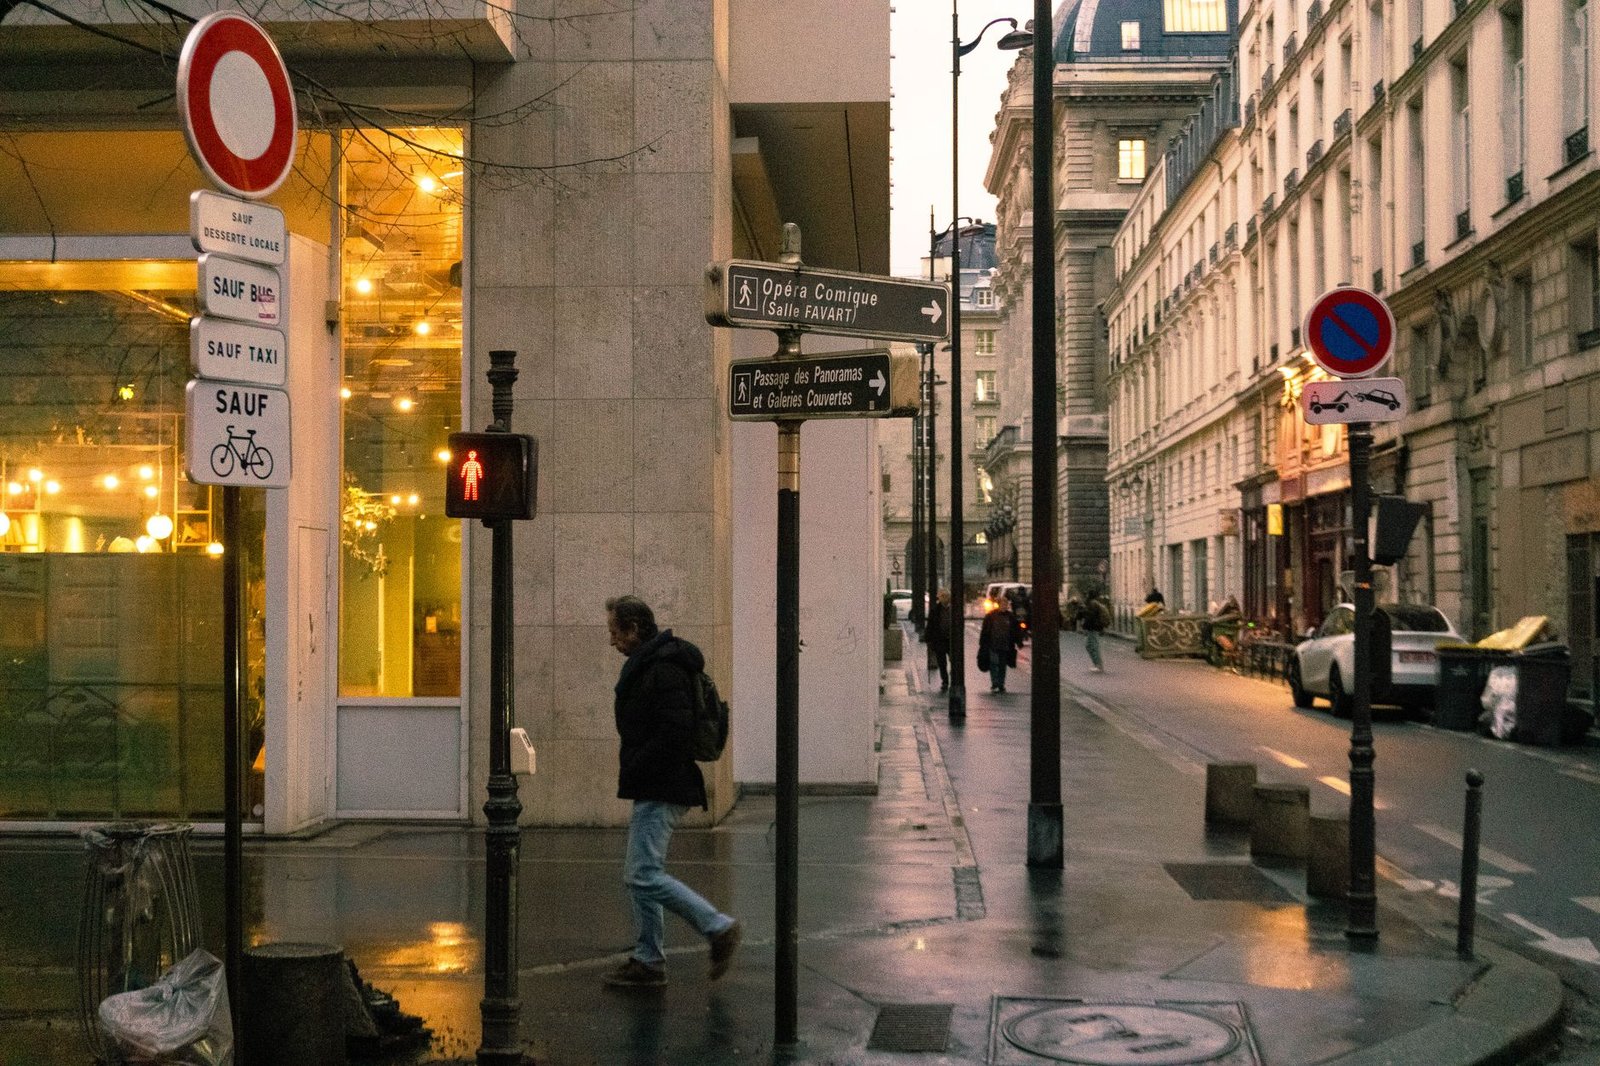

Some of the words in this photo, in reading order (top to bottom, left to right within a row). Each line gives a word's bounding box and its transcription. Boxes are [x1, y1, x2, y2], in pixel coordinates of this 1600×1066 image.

[232, 212, 253, 225] SAUF
[204, 227, 246, 245] DESSERTE
[249, 236, 279, 252] LOCALE
[213, 276, 245, 299] SAUF
[762, 278, 807, 298] Opéra
[815, 283, 878, 308] Comique
[762, 297, 800, 318] (Salle
[805, 304, 857, 324] FAVART)
[208, 340, 241, 359] SAUF
[249, 346, 278, 364] TAXI
[754, 370, 789, 389] Passage
[794, 368, 809, 384] des
[814, 366, 863, 383] Panoramas
[216, 389, 268, 417] SAUF
[753, 396, 763, 409] et
[767, 391, 802, 408] Galeries
[807, 389, 853, 407] Couvertes
